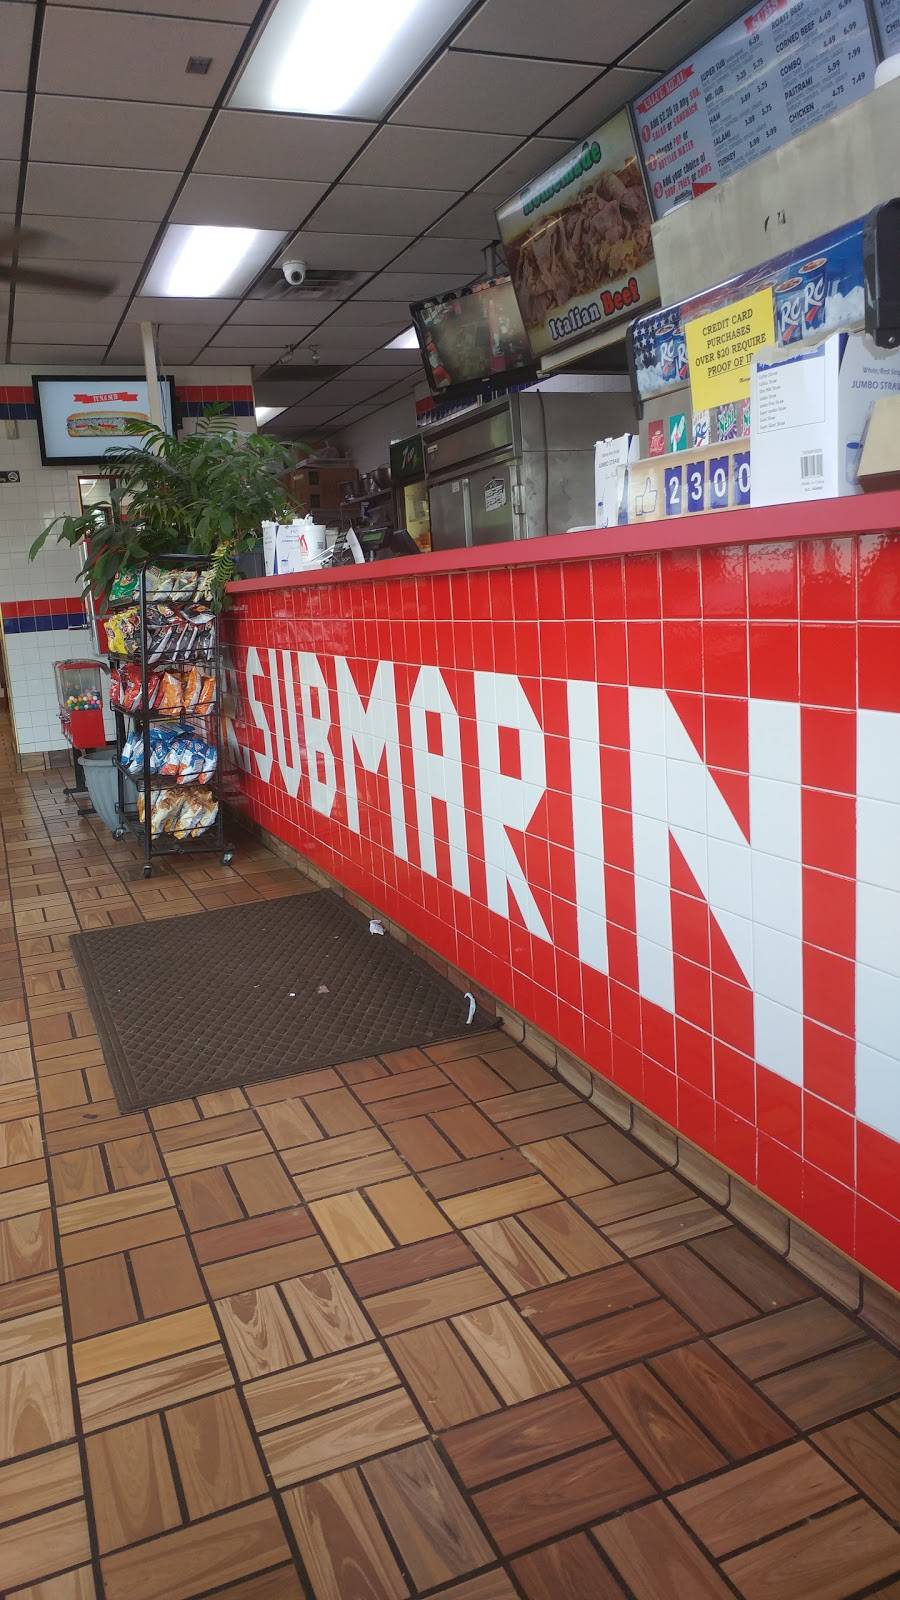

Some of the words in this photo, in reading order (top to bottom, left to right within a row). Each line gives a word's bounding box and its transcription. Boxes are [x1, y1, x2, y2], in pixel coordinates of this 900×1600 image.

[790, 2, 804, 17] BEEF
[776, 32, 800, 53] CORNED
[801, 20, 815, 37] BEEF
[819, 9, 831, 23] 4.49
[780, 57, 801, 76] COMBO
[843, 21, 857, 35] 6.99
[785, 76, 813, 100] PASTRAMI
[827, 60, 840, 73] 5.99
[848, 47, 861, 61] 7.99
[789, 102, 814, 123] CHICKEN
[832, 85, 844, 97] 4.75
[852, 72, 865, 86] 7.49
[709, 112, 720, 126] HAM
[713, 129, 731, 147] SALAMI
[672, 169, 683, 183] your
[683, 157, 699, 174] choice
[718, 150, 735, 167] TURKEY
[804, 275, 825, 313] RC
[549, 302, 602, 340] Italian
[600, 277, 640, 316] Beef
[702, 318, 730, 337] CREDIT
[731, 308, 754, 325] CARD
[781, 296, 801, 332] RC
[695, 353, 715, 367] OVER
[716, 347, 730, 359] $20
[732, 333, 767, 354] REQUIRE
[706, 325, 751, 349] PURCHASES
[661, 339, 675, 367] RC
[707, 360, 732, 377] PROOF
[734, 355, 745, 367] OF
[851, 380, 879, 390] JUMBO
